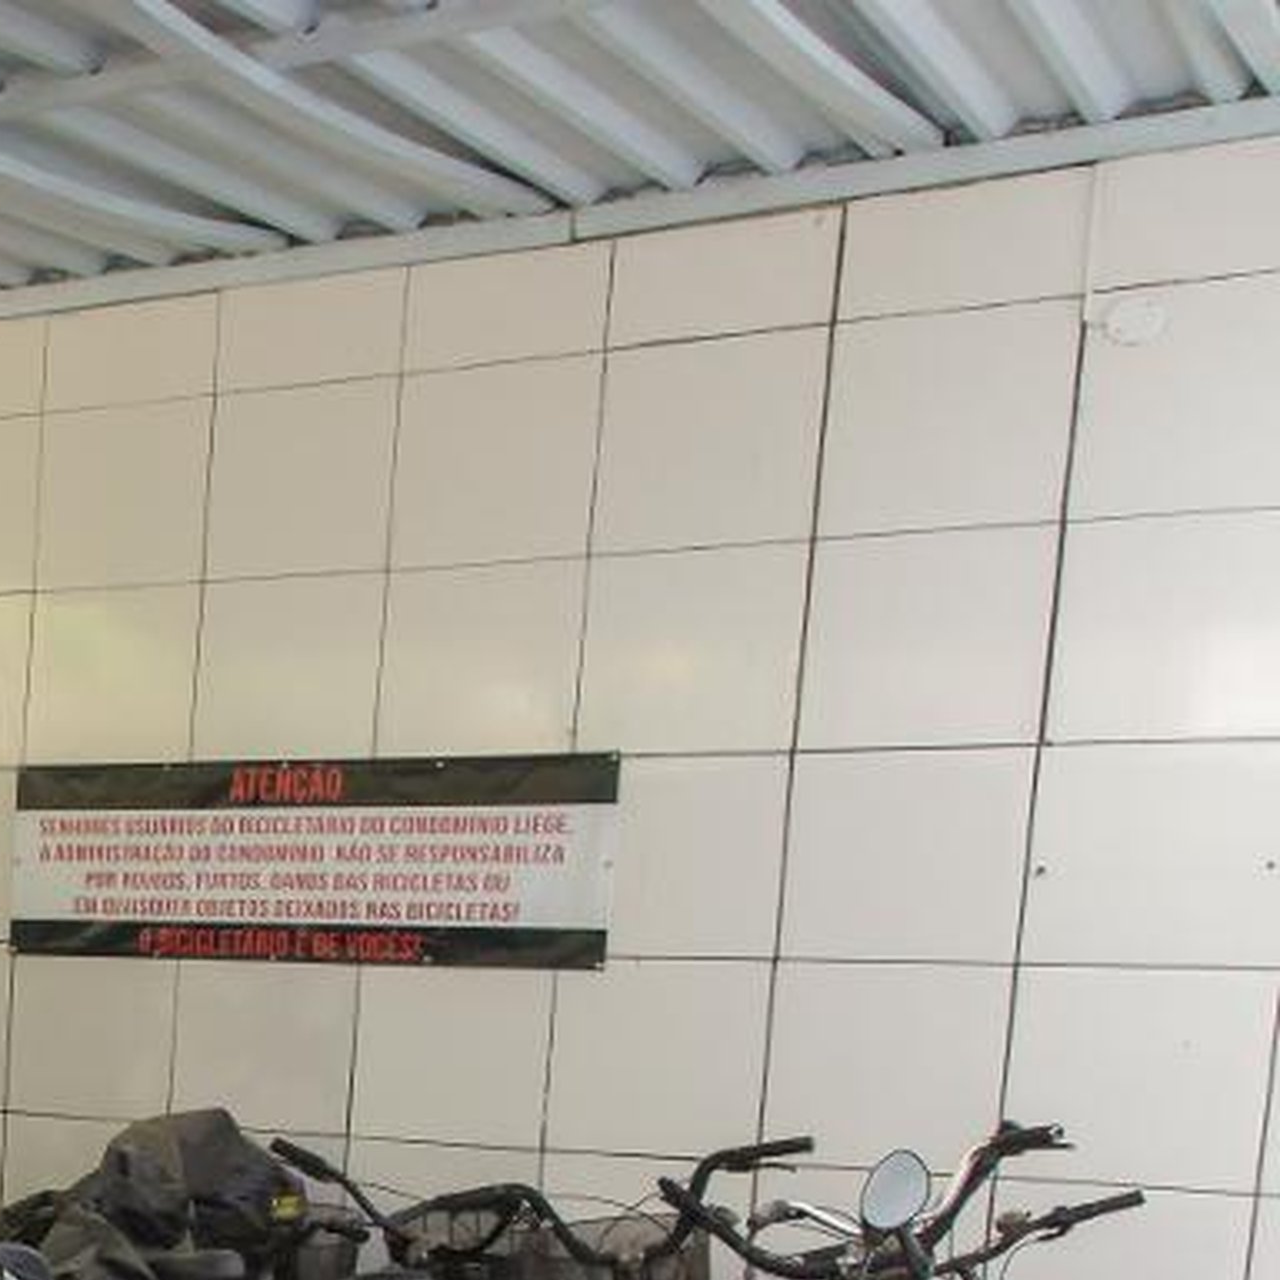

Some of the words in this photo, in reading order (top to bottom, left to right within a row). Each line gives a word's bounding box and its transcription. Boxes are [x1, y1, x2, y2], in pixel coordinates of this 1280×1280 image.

[230, 765, 343, 803] ATENÇÃO
[359, 815, 385, 834] DO
[54, 843, 183, 863] ADMINISTRAÇÃO
[376, 844, 399, 863] SE
[403, 844, 565, 864] RESPONSABILIZA
[85, 872, 116, 890] POR
[270, 873, 328, 892] DANOS
[373, 873, 478, 892] BICICLETAS
[482, 873, 511, 892] OU
[196, 899, 268, 917] OBJETOS
[274, 899, 360, 918] DEIXADOS
[313, 932, 340, 957] DE
